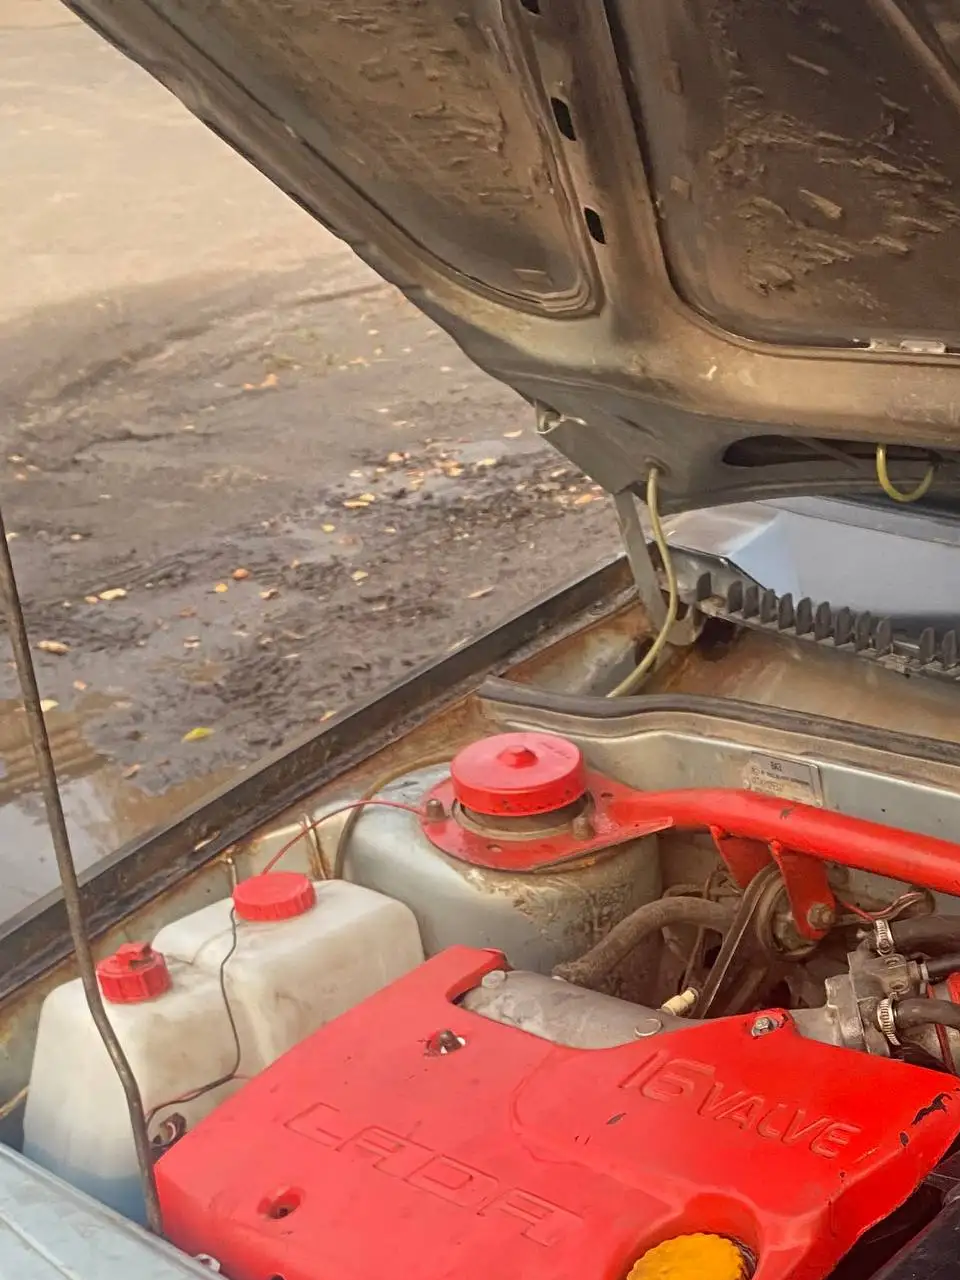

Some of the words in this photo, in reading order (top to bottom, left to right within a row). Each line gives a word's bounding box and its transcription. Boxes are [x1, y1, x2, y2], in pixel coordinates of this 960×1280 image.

[617, 1050, 717, 1104] 16
[693, 1081, 864, 1159] VALVE
[282, 1102, 584, 1247] LADA
